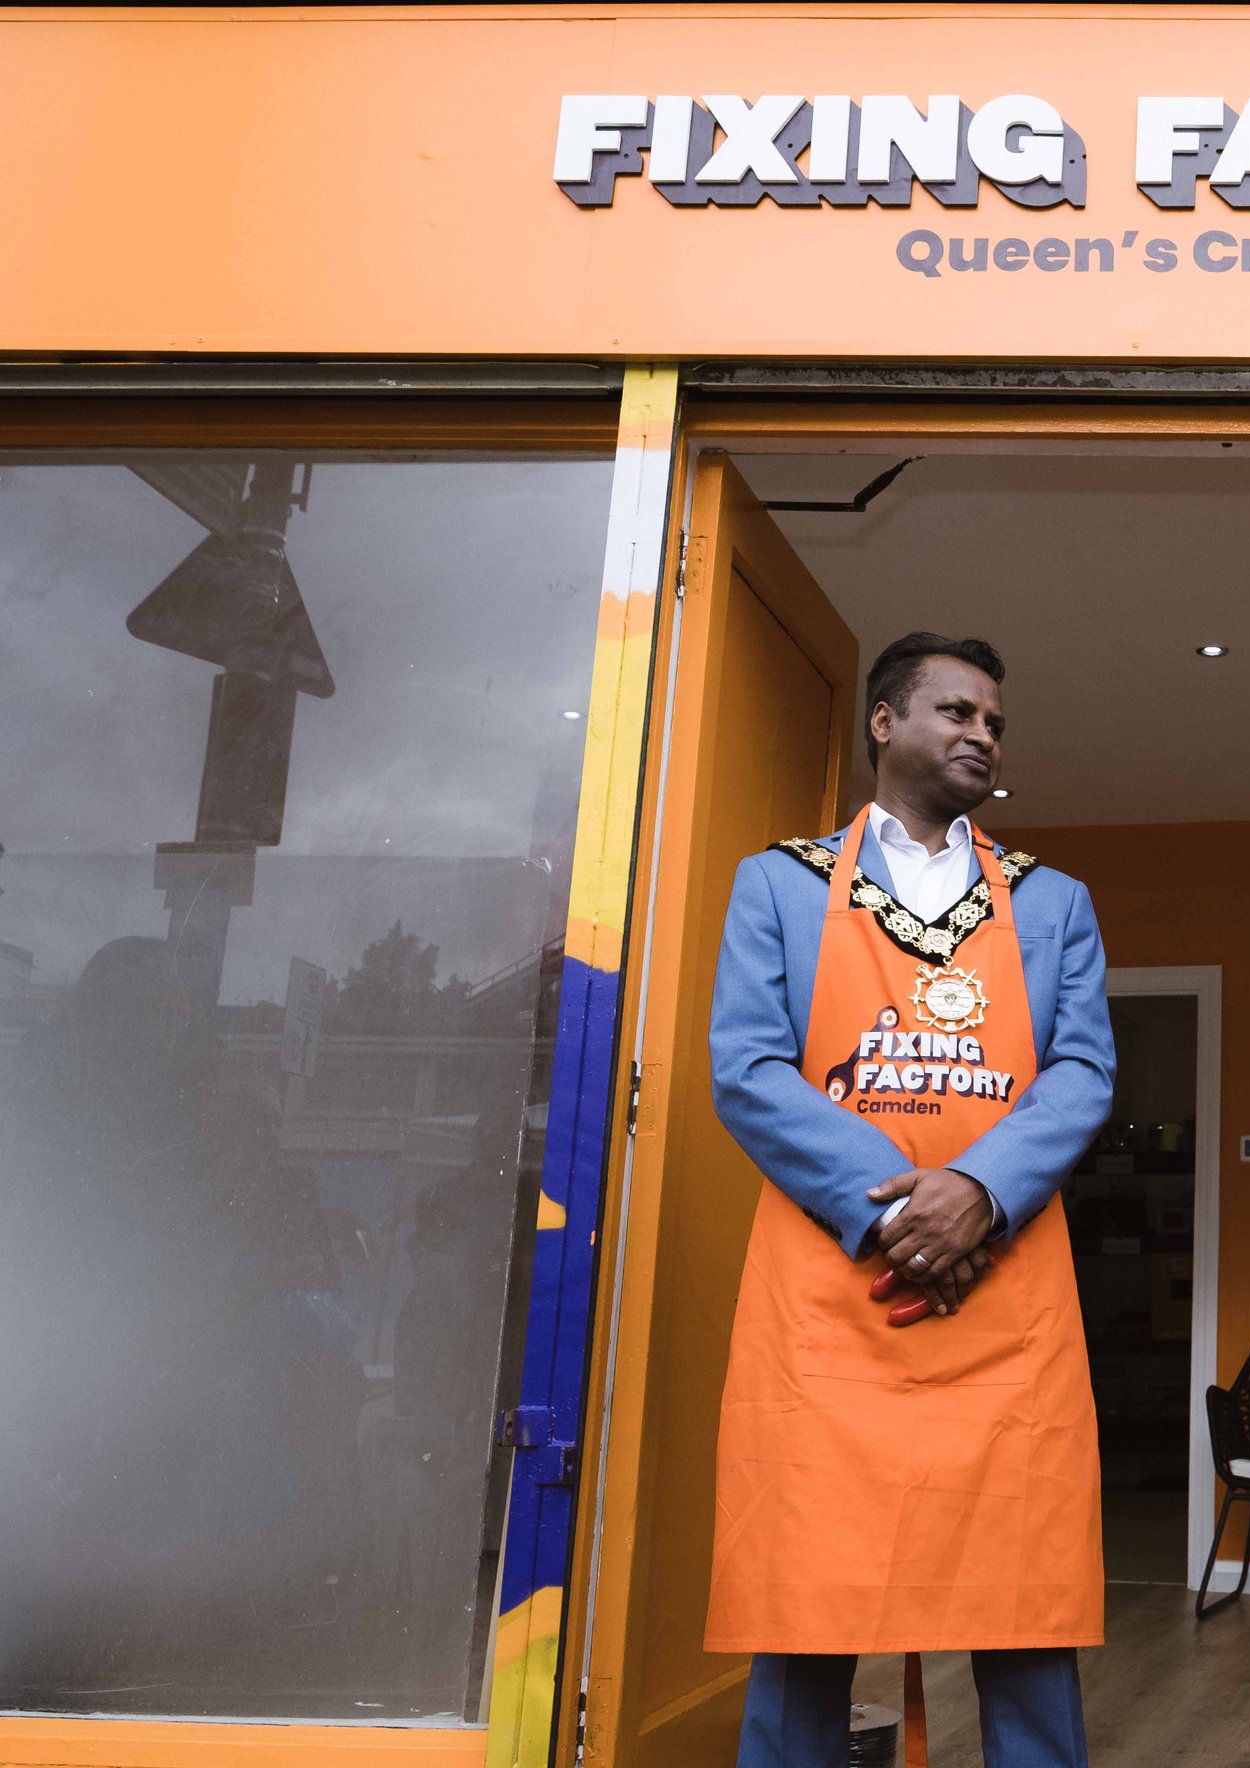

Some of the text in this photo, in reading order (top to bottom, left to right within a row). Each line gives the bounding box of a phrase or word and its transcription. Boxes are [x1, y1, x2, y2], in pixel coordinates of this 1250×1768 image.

[552, 93, 1068, 186] FIXING
[895, 229, 1178, 278] Queen’s
[858, 1031, 982, 1063] FIXING
[857, 1063, 1012, 1098] FACTORY
[856, 1098, 942, 1115] Camden
